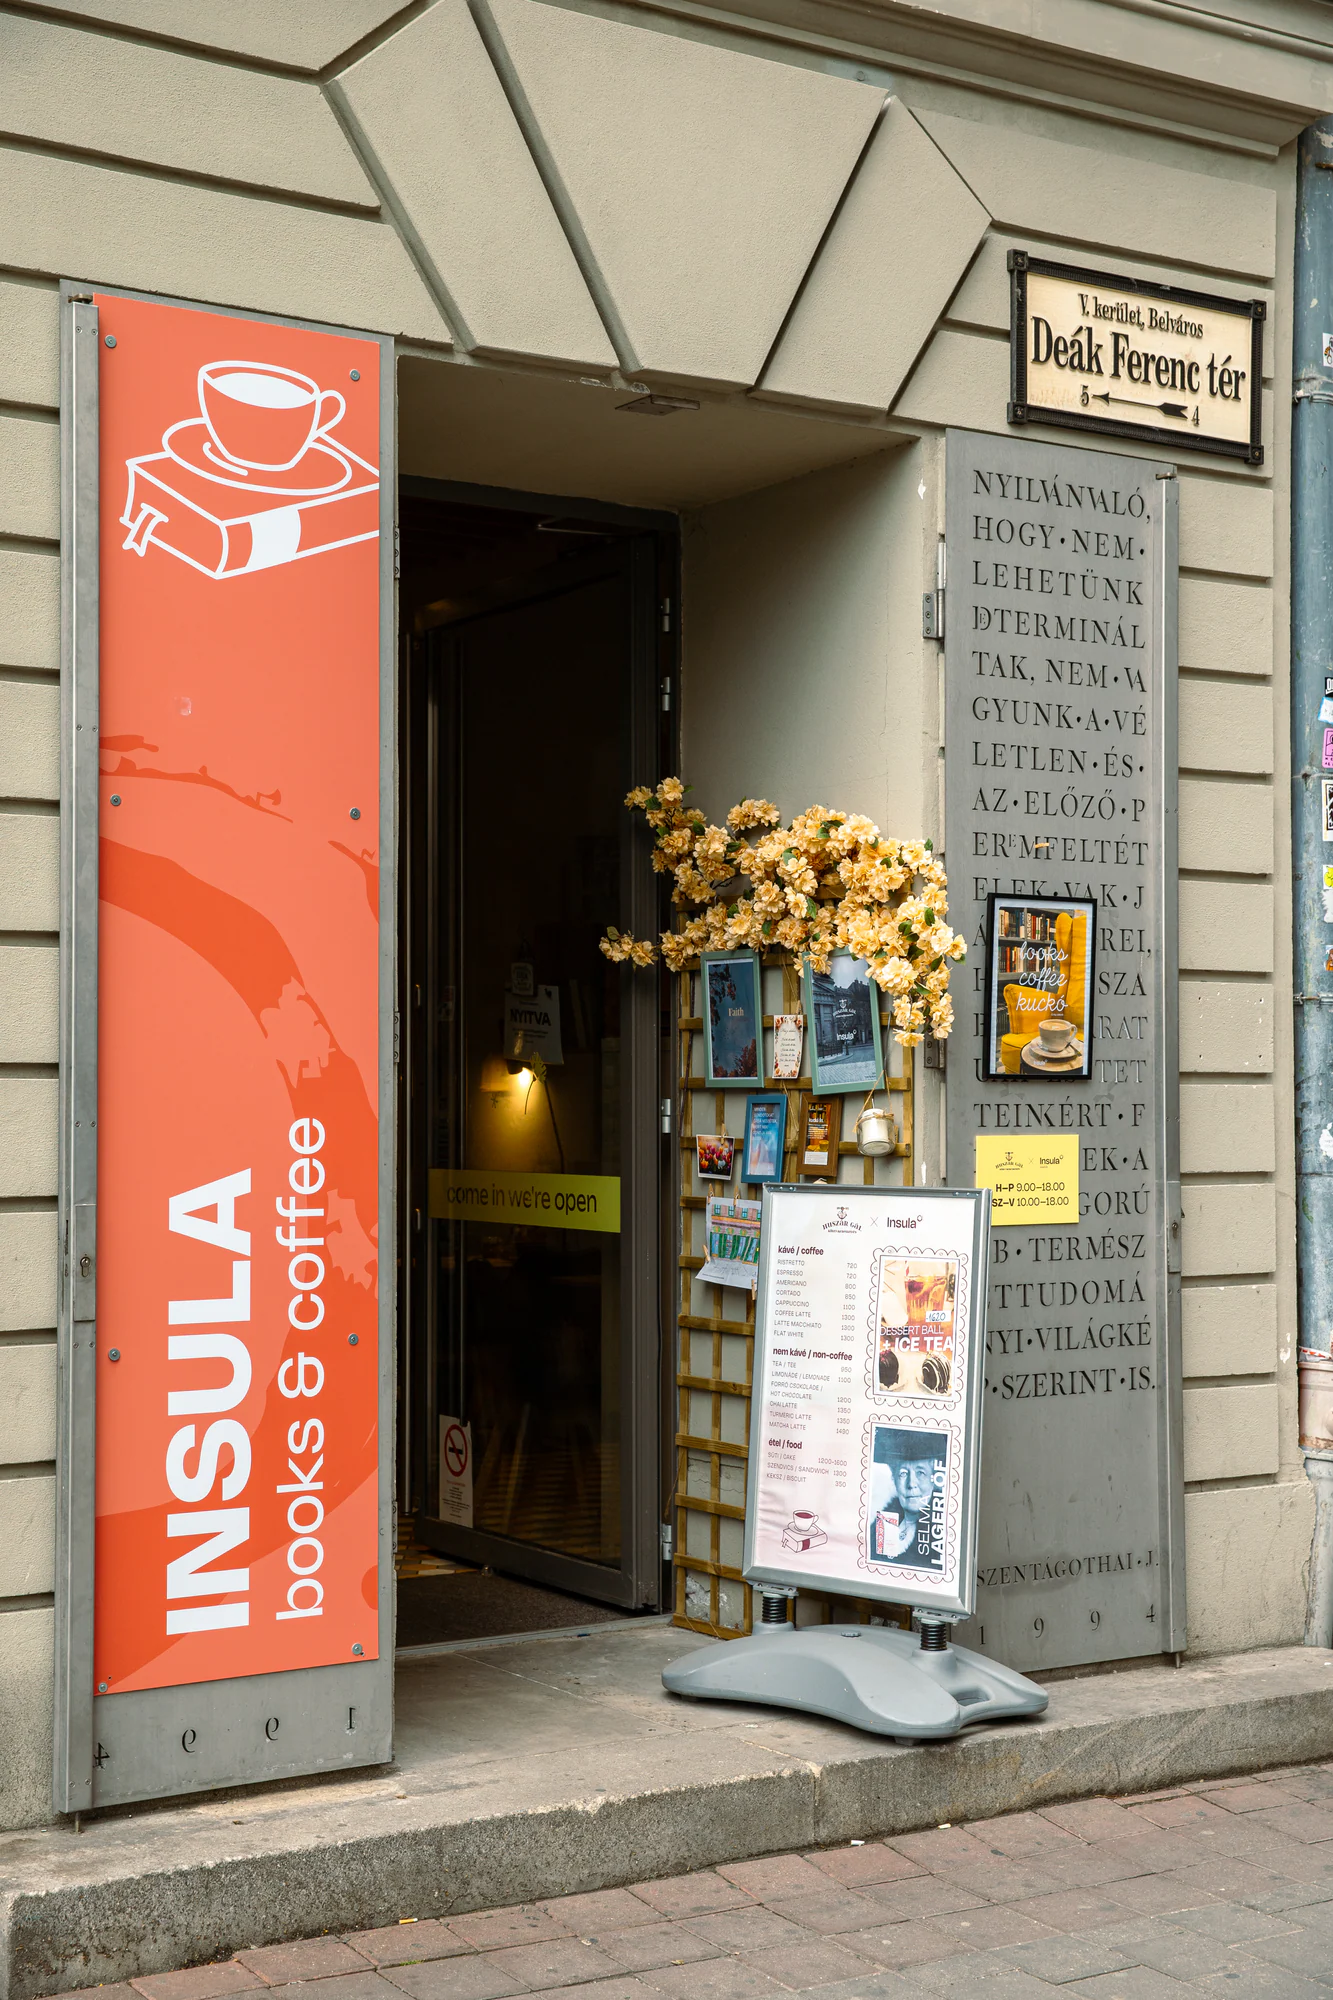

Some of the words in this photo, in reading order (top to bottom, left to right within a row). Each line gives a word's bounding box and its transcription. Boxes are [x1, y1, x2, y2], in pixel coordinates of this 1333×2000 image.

[1078, 293, 1089, 316] V.
[1093, 296, 1145, 330] kerület,
[1149, 308, 1203, 338] Belváros
[1031, 316, 1104, 375] Deák
[1110, 331, 1200, 392] Ferenc
[1206, 353, 1246, 400] tér
[1080, 385, 1089, 406] 5
[1191, 406, 1200, 426] 4
[973, 470, 1150, 524] NYILVÁNVALÓ,
[972, 560, 1143, 605] LEHETÜNK
[972, 651, 1035, 685] TAK,
[972, 696, 1074, 729] GYUNK
[1113, 705, 1146, 736] VÉ
[972, 741, 1087, 774] LETLEN
[972, 787, 1008, 812] AZ
[1024, 786, 1116, 820] ELŐZŐ
[1132, 799, 1145, 822] P
[1134, 886, 1144, 909] J
[1020, 940, 1068, 961] books
[1018, 968, 1067, 992] coffee
[510, 1008, 551, 1026] NYITVA
[728, 1007, 744, 1017] Faith
[1016, 992, 1068, 1012] kuckó
[446, 1186, 488, 1205] come
[492, 1184, 504, 1206] in
[508, 1186, 550, 1209] we're
[554, 1192, 597, 1215] open
[1078, 1184, 1150, 1216] GORÚ
[275, 1116, 325, 1331] coffee
[778, 1245, 794, 1254] kávé
[801, 1247, 824, 1255] coffee
[1029, 1228, 1146, 1262] TERMÉSZ
[988, 1271, 1146, 1310] TTUDOMÁ
[880, 1325, 920, 1335] DESSERT
[922, 1325, 944, 1335] BALL
[894, 1337, 919, 1352] ICE
[924, 1336, 954, 1352] TEA
[1035, 1314, 1152, 1351] VILÁGKÉ
[790, 1348, 806, 1357] kávé
[813, 1352, 852, 1360] non-coffee
[278, 1351, 324, 1398] &
[1001, 1368, 1118, 1400] SZERINT
[166, 1167, 252, 1636] INSULA
[769, 1438, 781, 1446] étel
[787, 1440, 802, 1449] food
[798, 1466, 829, 1474] SANDWICH
[275, 1417, 324, 1621] books
[918, 1495, 931, 1556] SELMA
[931, 1460, 947, 1566] LAGERLÖF
